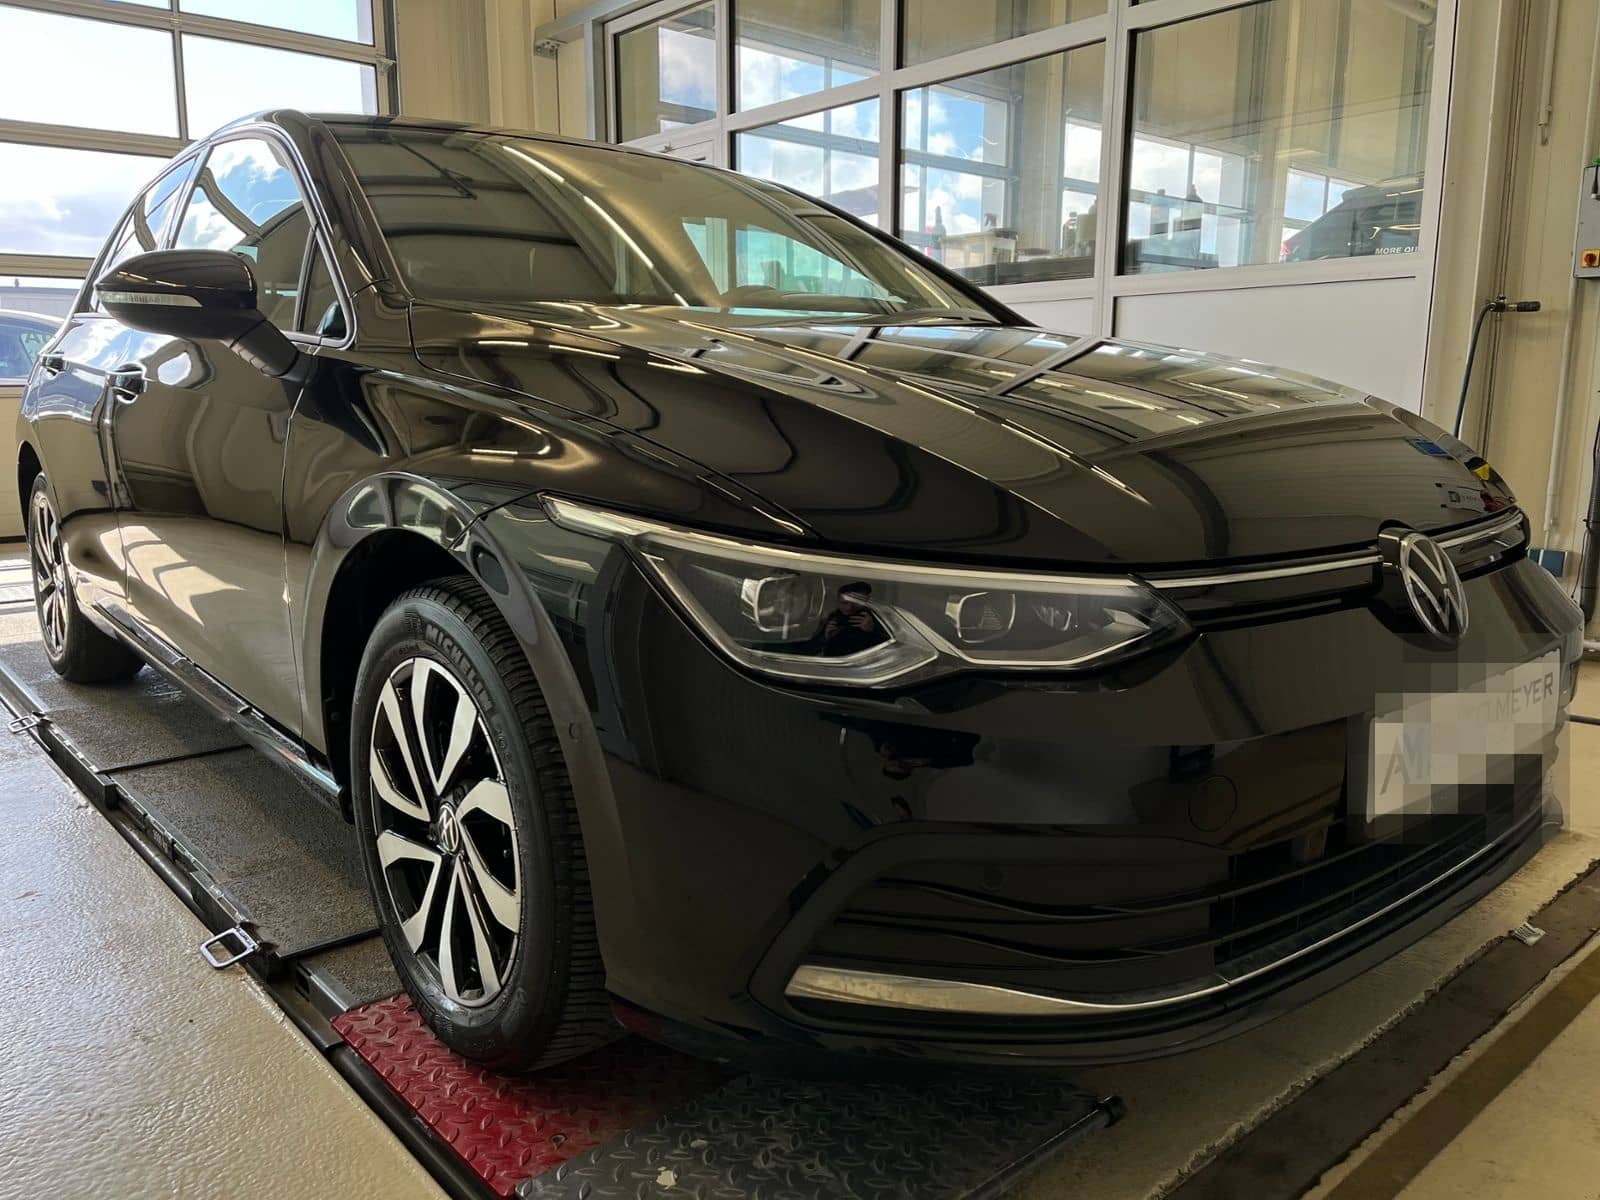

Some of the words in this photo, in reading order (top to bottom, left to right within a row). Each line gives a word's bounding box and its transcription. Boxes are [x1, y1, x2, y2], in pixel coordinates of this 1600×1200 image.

[1375, 247, 1401, 255] MORE
[424, 623, 493, 712] MICHELIN
[1496, 672, 1554, 720] MEYER
